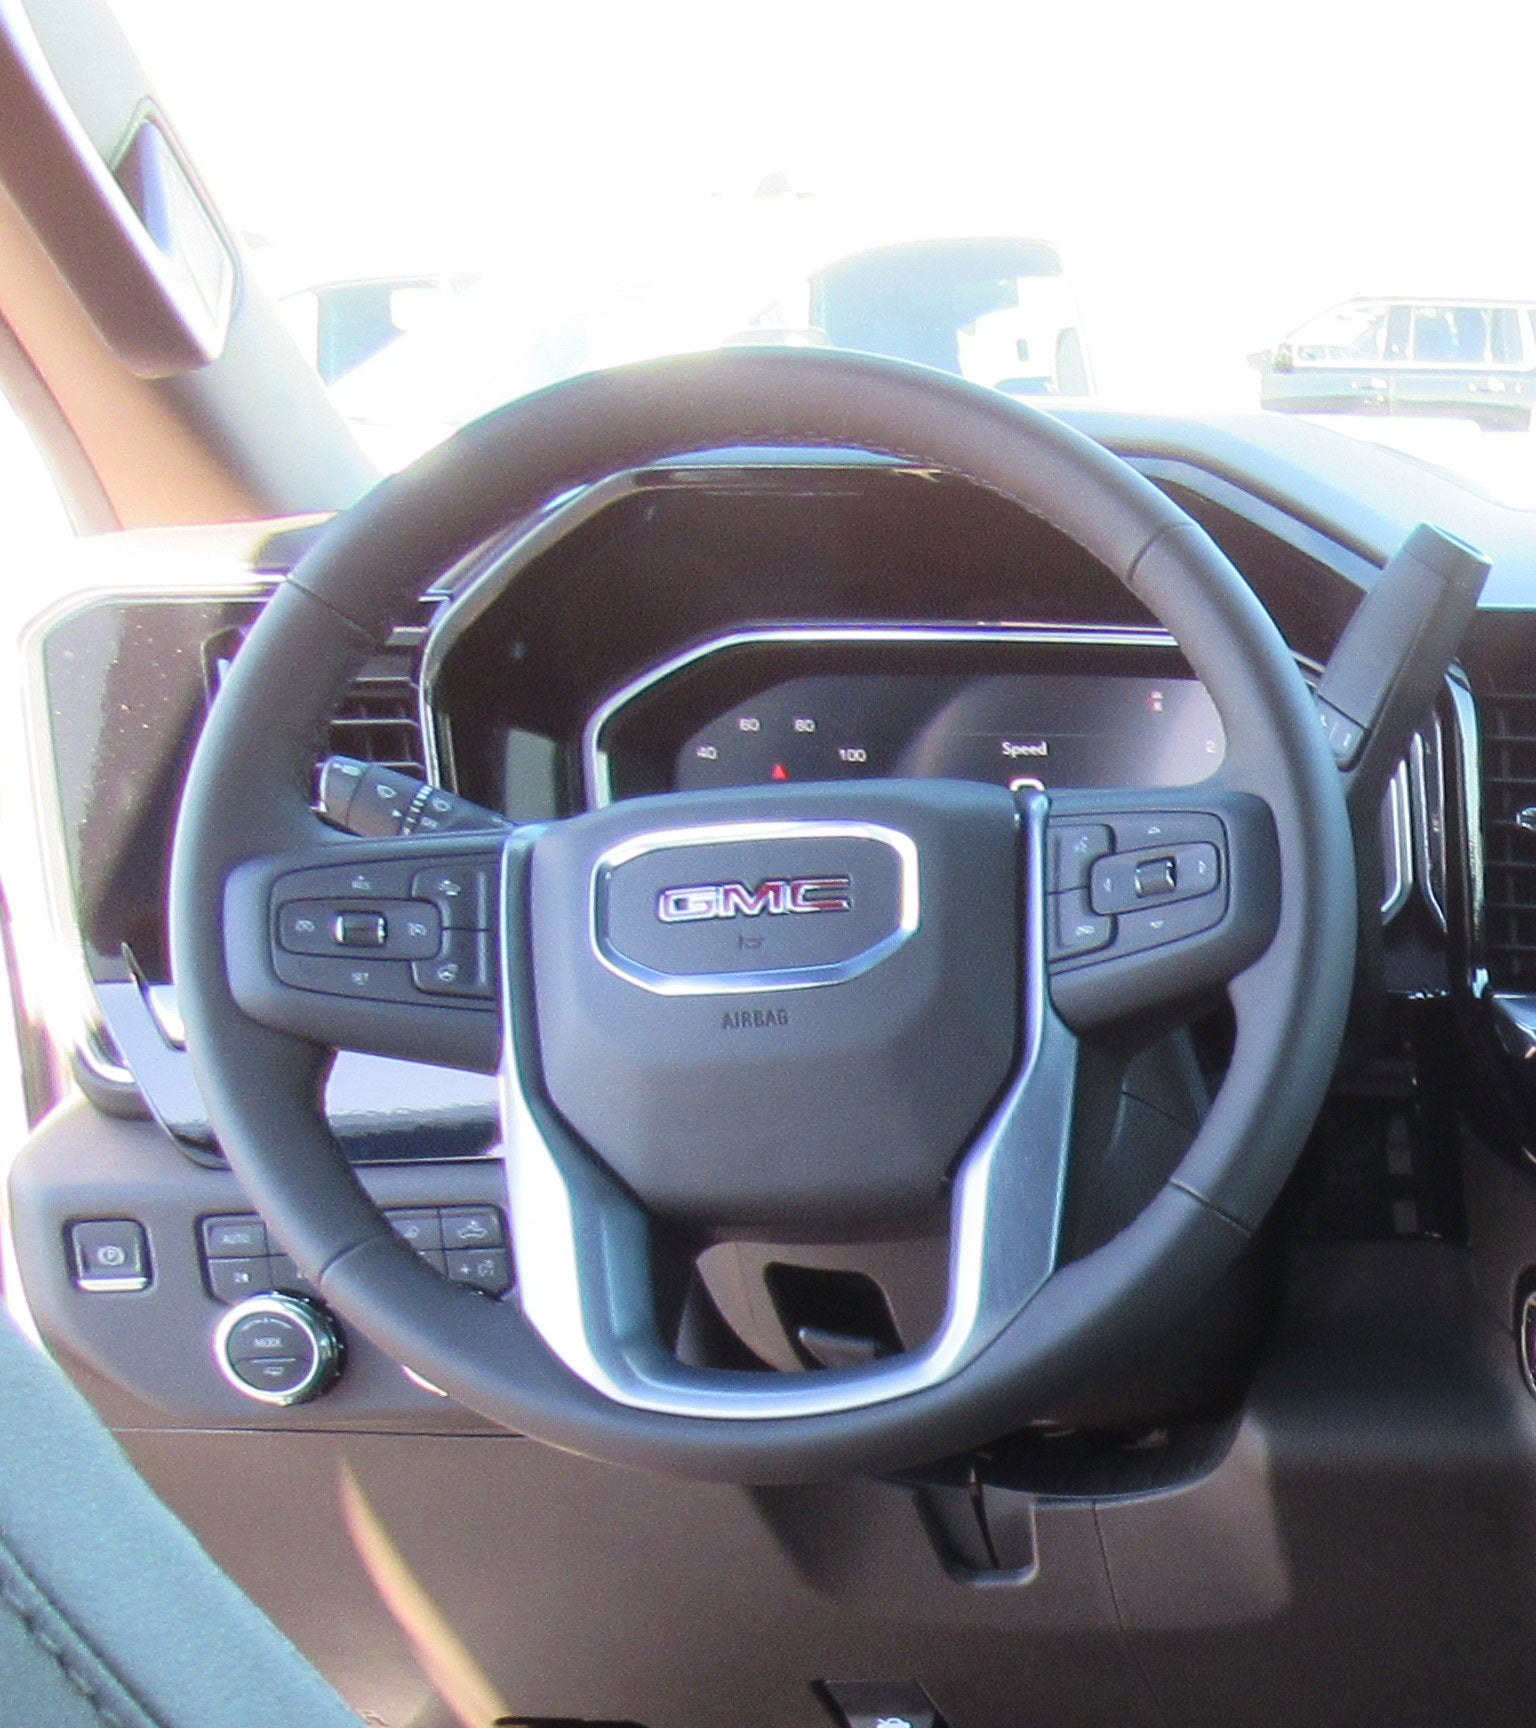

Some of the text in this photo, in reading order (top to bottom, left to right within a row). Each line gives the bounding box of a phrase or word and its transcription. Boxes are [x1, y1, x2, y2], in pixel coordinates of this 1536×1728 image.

[739, 717, 761, 733] 60
[793, 717, 816, 733] 80
[697, 745, 718, 760] 40
[838, 748, 868, 763] 100
[1001, 740, 1048, 759] Speed
[658, 875, 852, 924] GMC
[722, 1008, 789, 1030] AIRBAG
